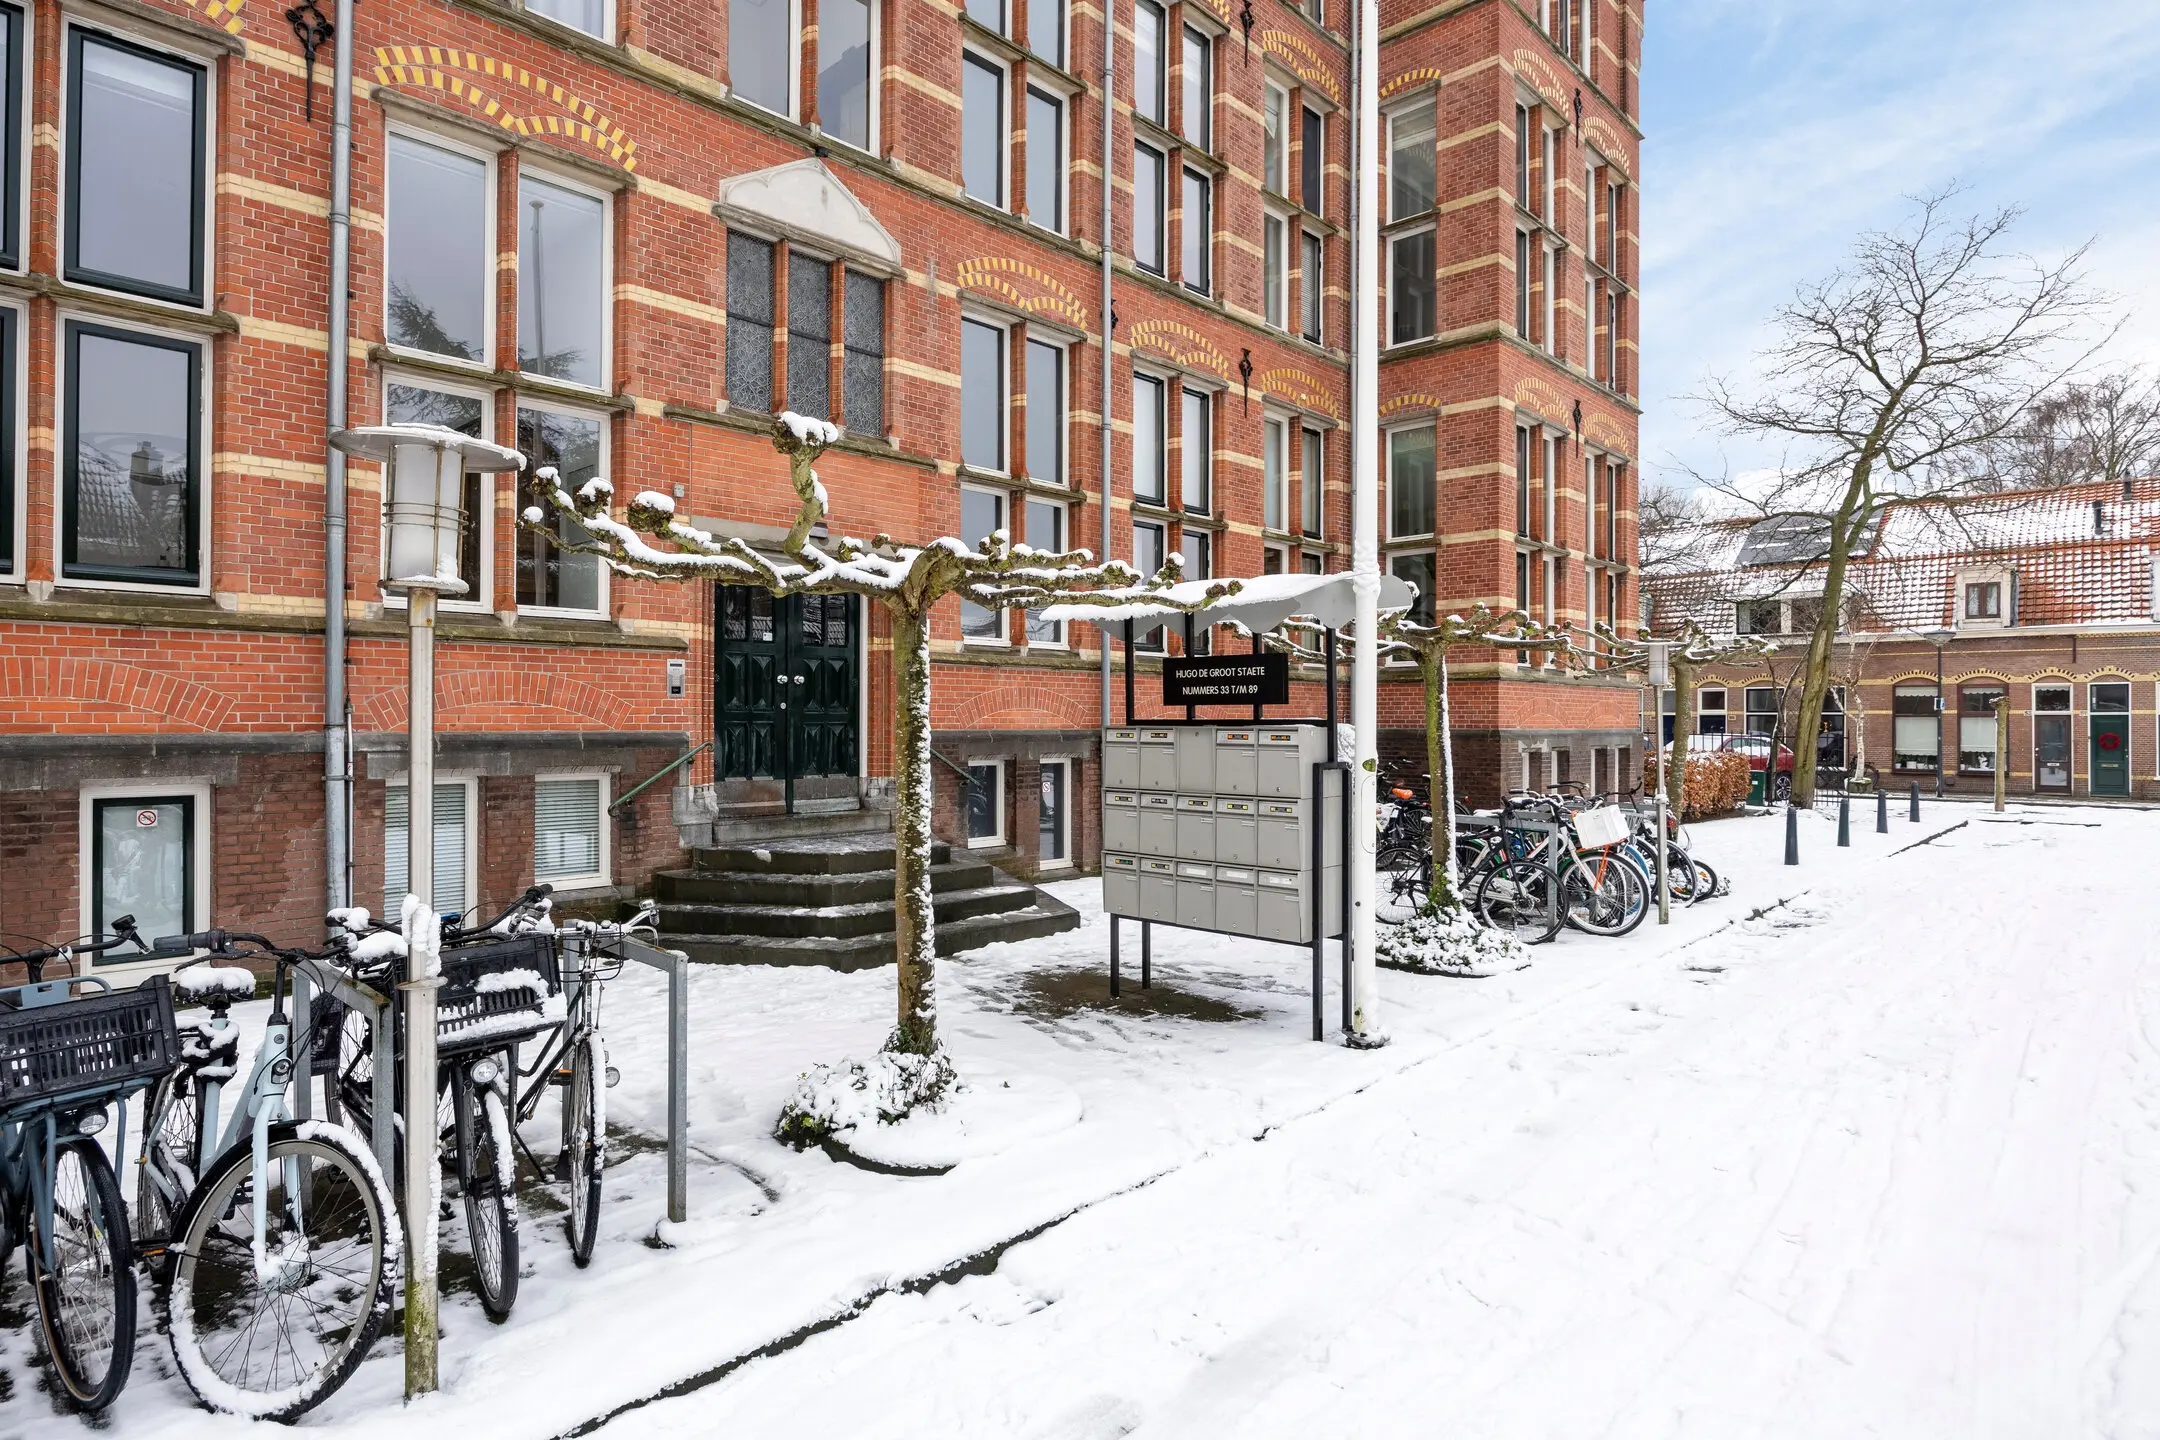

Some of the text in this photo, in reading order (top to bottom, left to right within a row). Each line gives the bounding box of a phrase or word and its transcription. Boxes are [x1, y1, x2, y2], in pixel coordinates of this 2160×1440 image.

[1176, 666, 1265, 678] HUGO DE GROOT STAETE
[1182, 684, 1258, 695] NUMMERS 33 T/M 89
